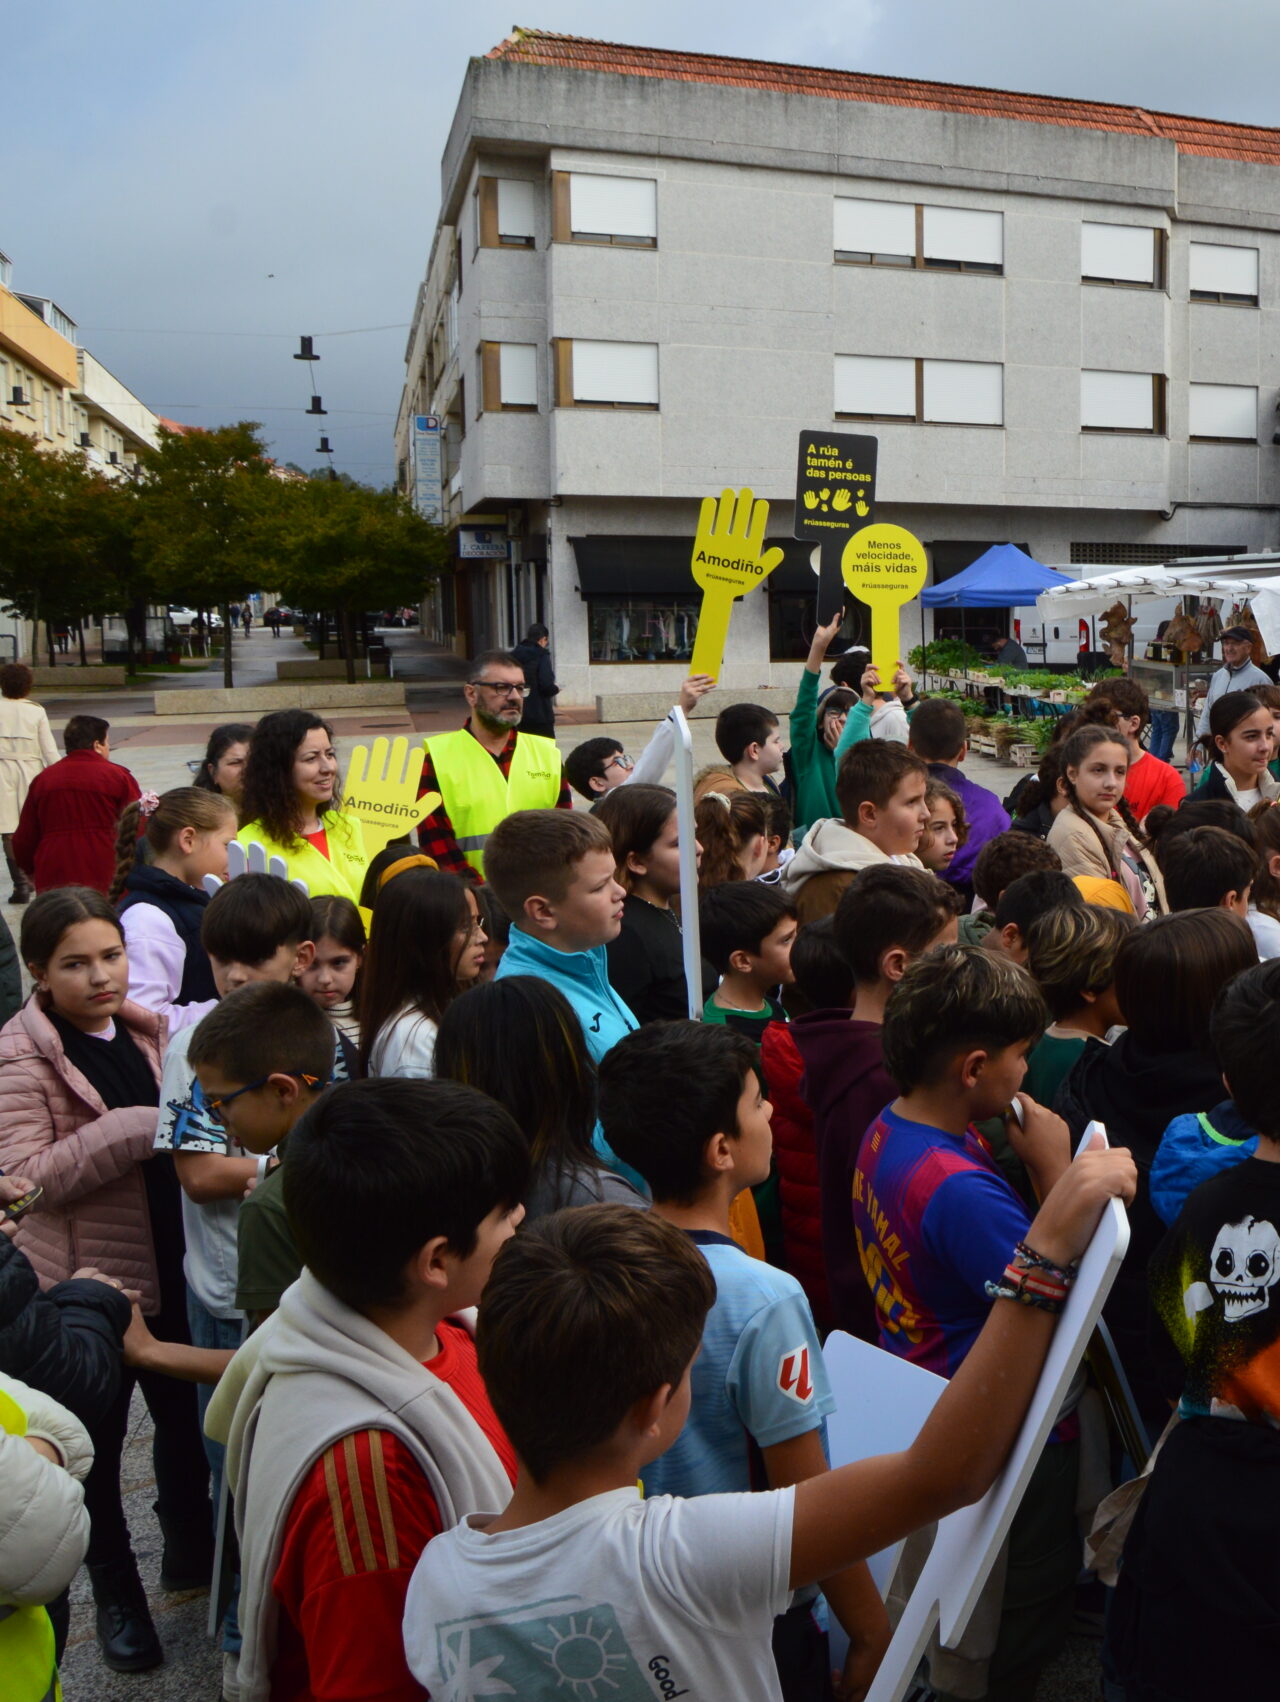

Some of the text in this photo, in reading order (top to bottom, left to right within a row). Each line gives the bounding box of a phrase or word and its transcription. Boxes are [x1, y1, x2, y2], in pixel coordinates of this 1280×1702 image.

[807, 443, 839, 456] A rúa
[806, 456, 854, 470] tamén é
[806, 467, 872, 482] das persoas
[803, 519, 850, 529] #rúasseguras
[867, 540, 901, 550] Menos
[855, 551, 914, 561] velocidade,
[695, 550, 764, 576] Amodiño
[852, 561, 918, 574] máis vidas
[861, 582, 909, 591] #rúasseguras
[345, 795, 421, 819] Amodiño
[648, 1655, 690, 1702] Good
